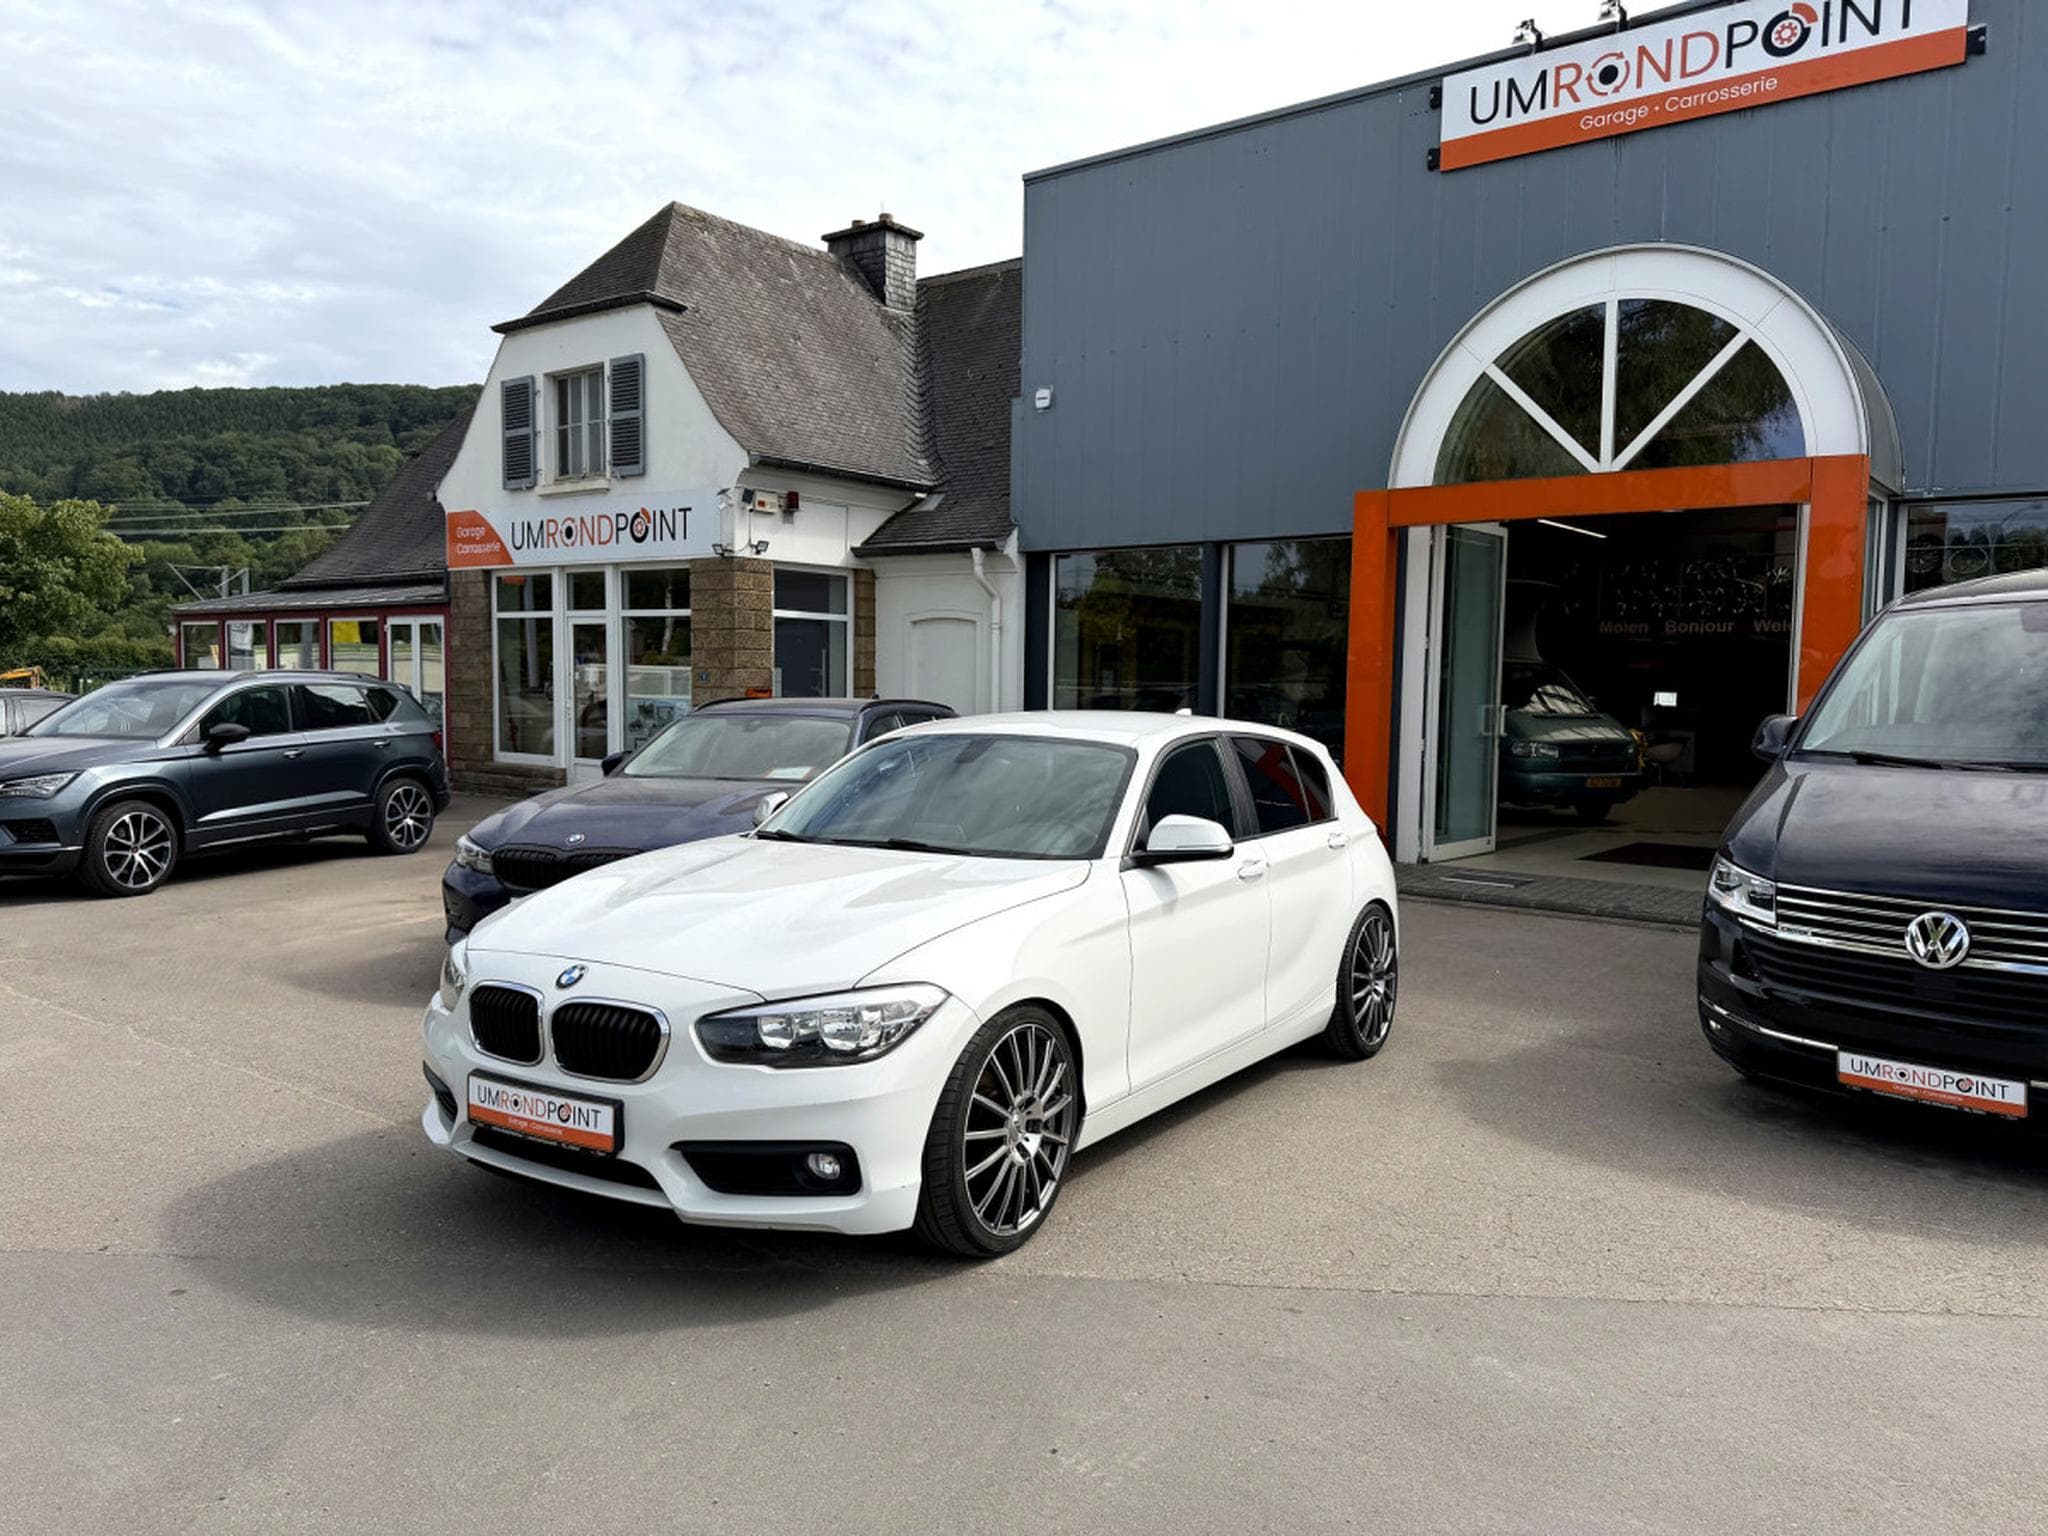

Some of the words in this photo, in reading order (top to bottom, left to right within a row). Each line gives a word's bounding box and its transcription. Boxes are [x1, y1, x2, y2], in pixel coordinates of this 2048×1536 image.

[1579, 103, 1649, 132] Garage
[1665, 75, 1778, 113] Carrosserie
[511, 507, 693, 550] UMRONDPOINT
[1851, 1058, 2009, 1099] UMRONDPOINT
[477, 1085, 602, 1129] UMRONDPOINT
